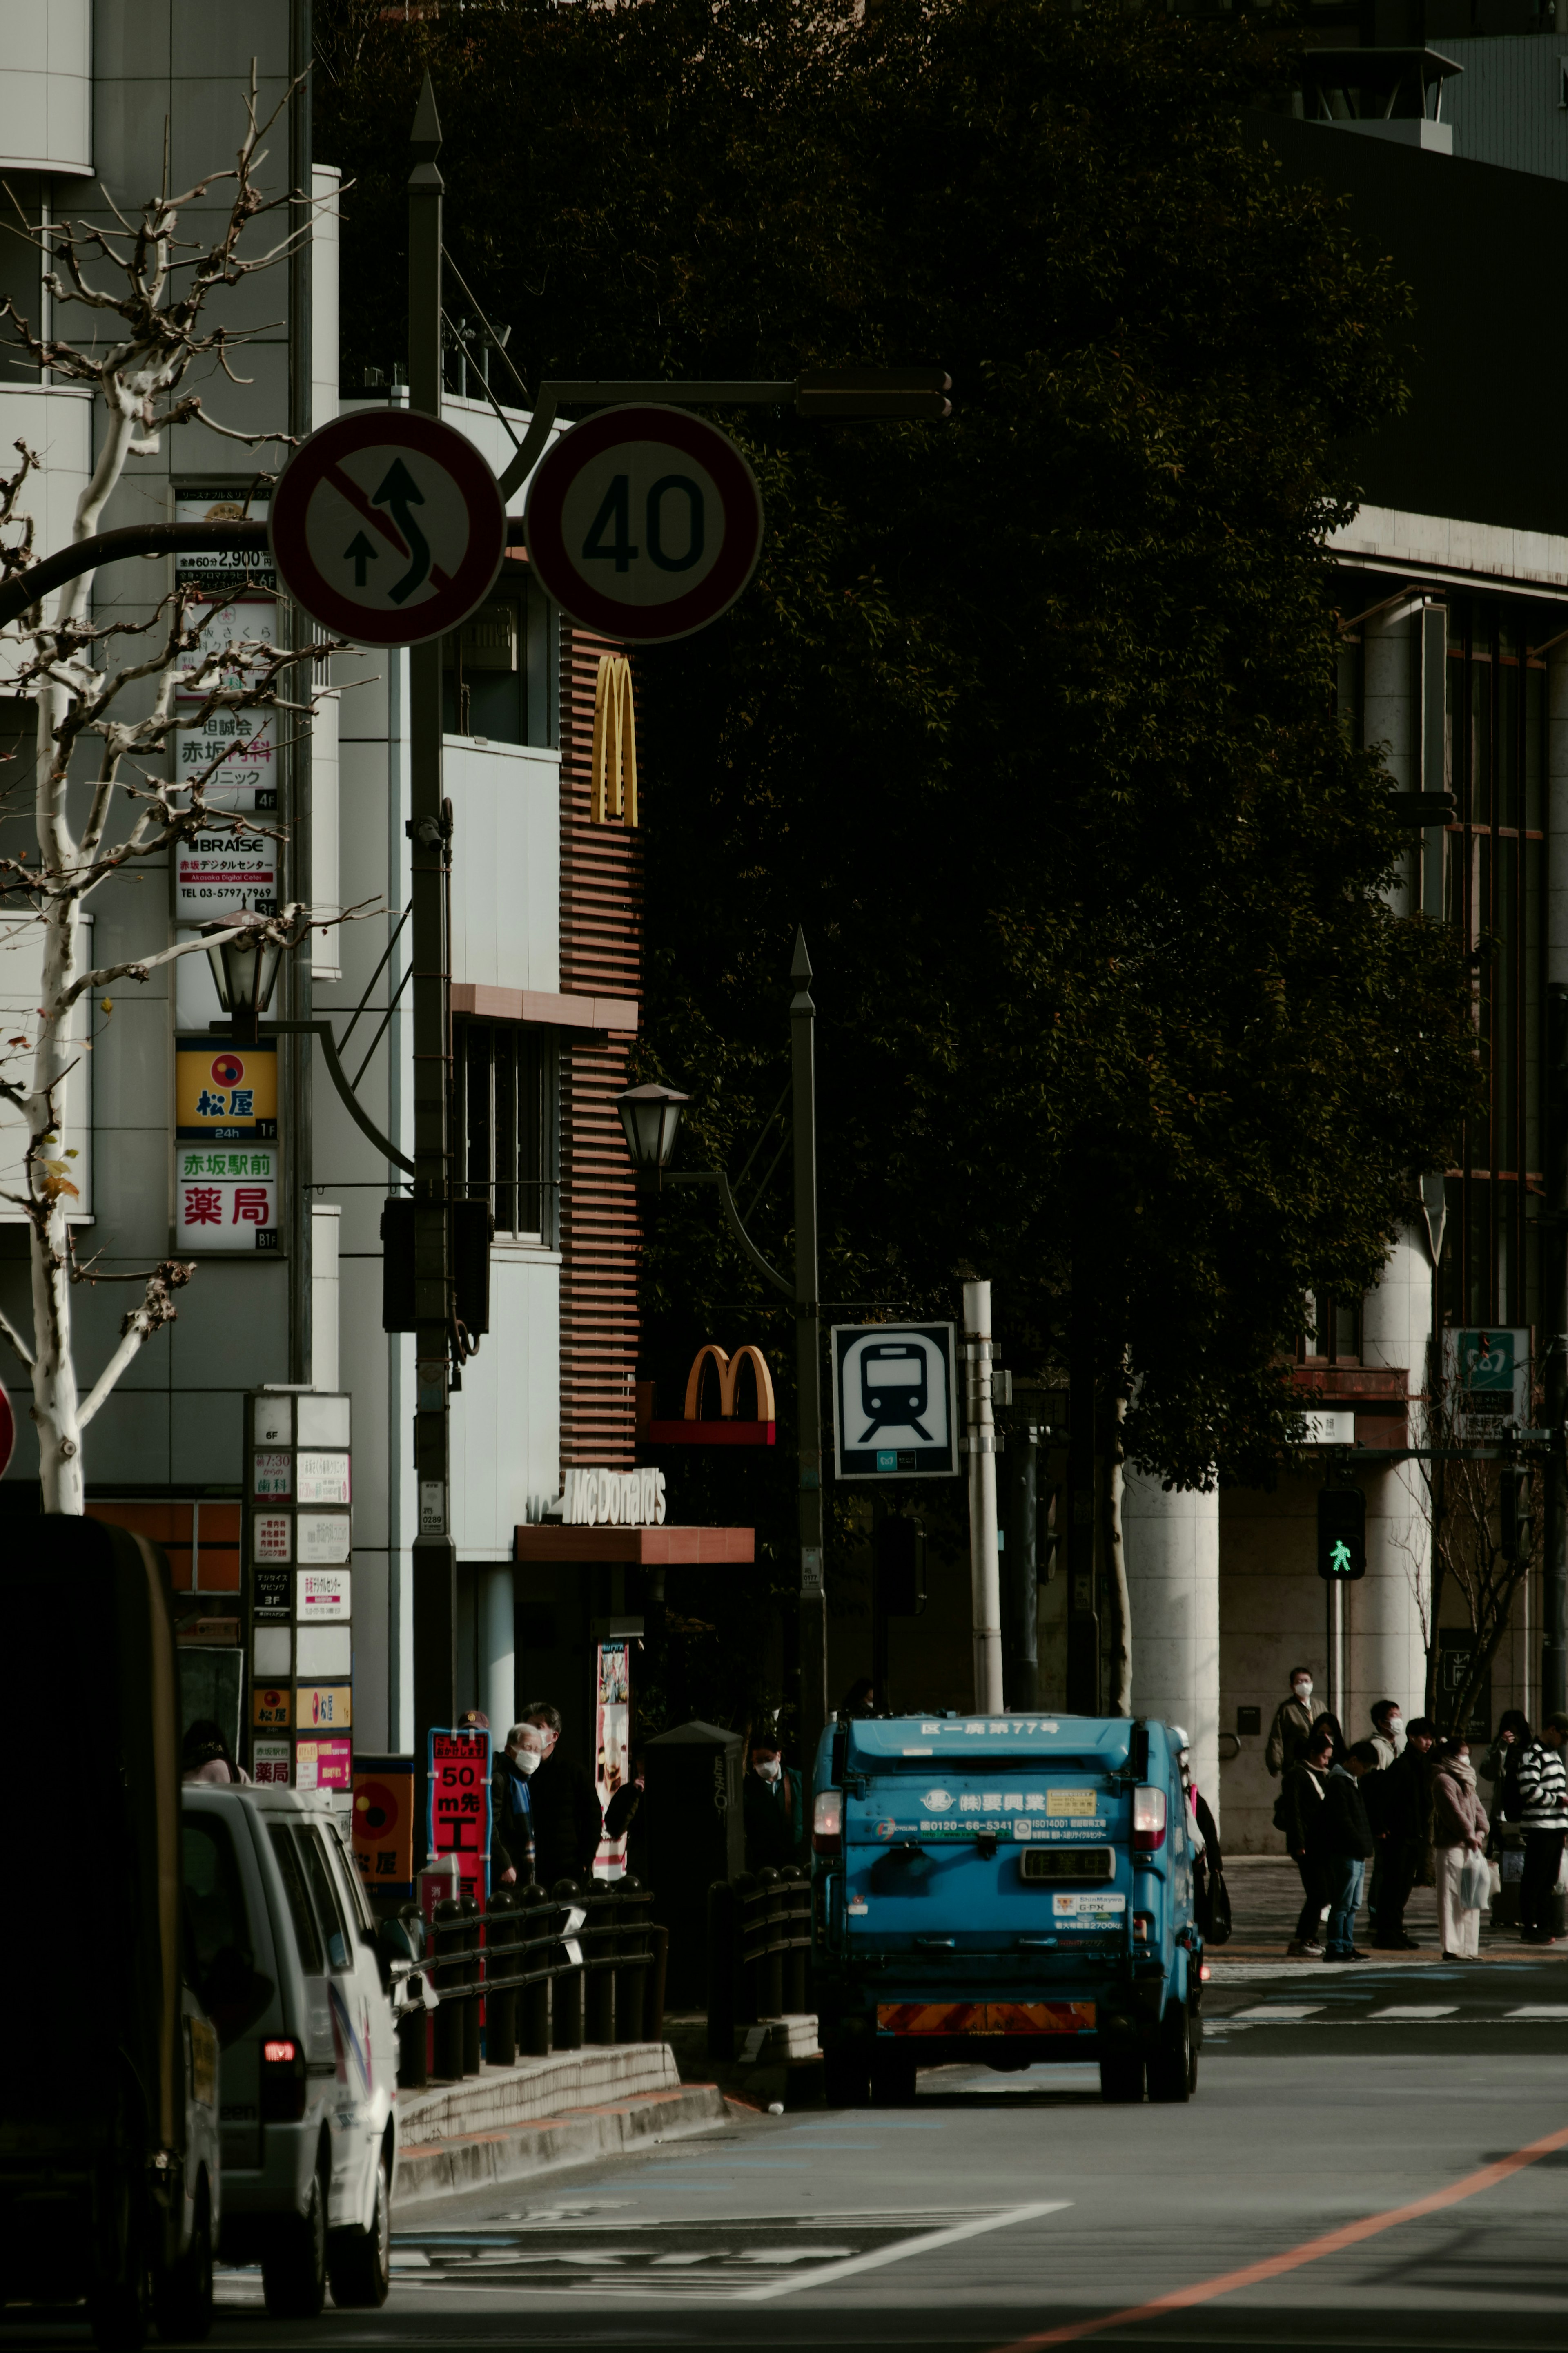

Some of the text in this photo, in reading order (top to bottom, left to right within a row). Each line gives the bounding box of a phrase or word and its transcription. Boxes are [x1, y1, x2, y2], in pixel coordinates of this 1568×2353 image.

[582, 475, 704, 572] 40
[180, 557, 217, 567] 全身60分
[259, 574, 274, 587] 6F
[258, 793, 274, 807] 4F
[200, 839, 263, 852] BRAISE
[180, 860, 273, 870] 赤坂デジタルセンター
[182, 889, 196, 897] TEL
[259, 903, 274, 916] 3F
[196, 1090, 253, 1116] 松屋
[215, 1128, 239, 1138] 24h
[261, 1123, 275, 1137] 1F
[184, 1154, 270, 1175] 赤坂駅前
[185, 1187, 269, 1225] 薬局
[259, 1233, 276, 1246] B1F
[266, 1431, 278, 1439] 6F
[265, 1455, 290, 1466] 7:30
[258, 1479, 286, 1493] 歯科
[264, 1596, 281, 1605] 3F
[258, 1709, 286, 1722] 松屋
[437, 1747, 482, 1756] おかけします
[256, 1762, 288, 1783] 薬局
[442, 1767, 474, 1787] 50
[438, 1793, 480, 1813] m先
[931, 1821, 1012, 1831] 0120-66-5341
[1033, 1820, 1068, 1828] ISO14001
